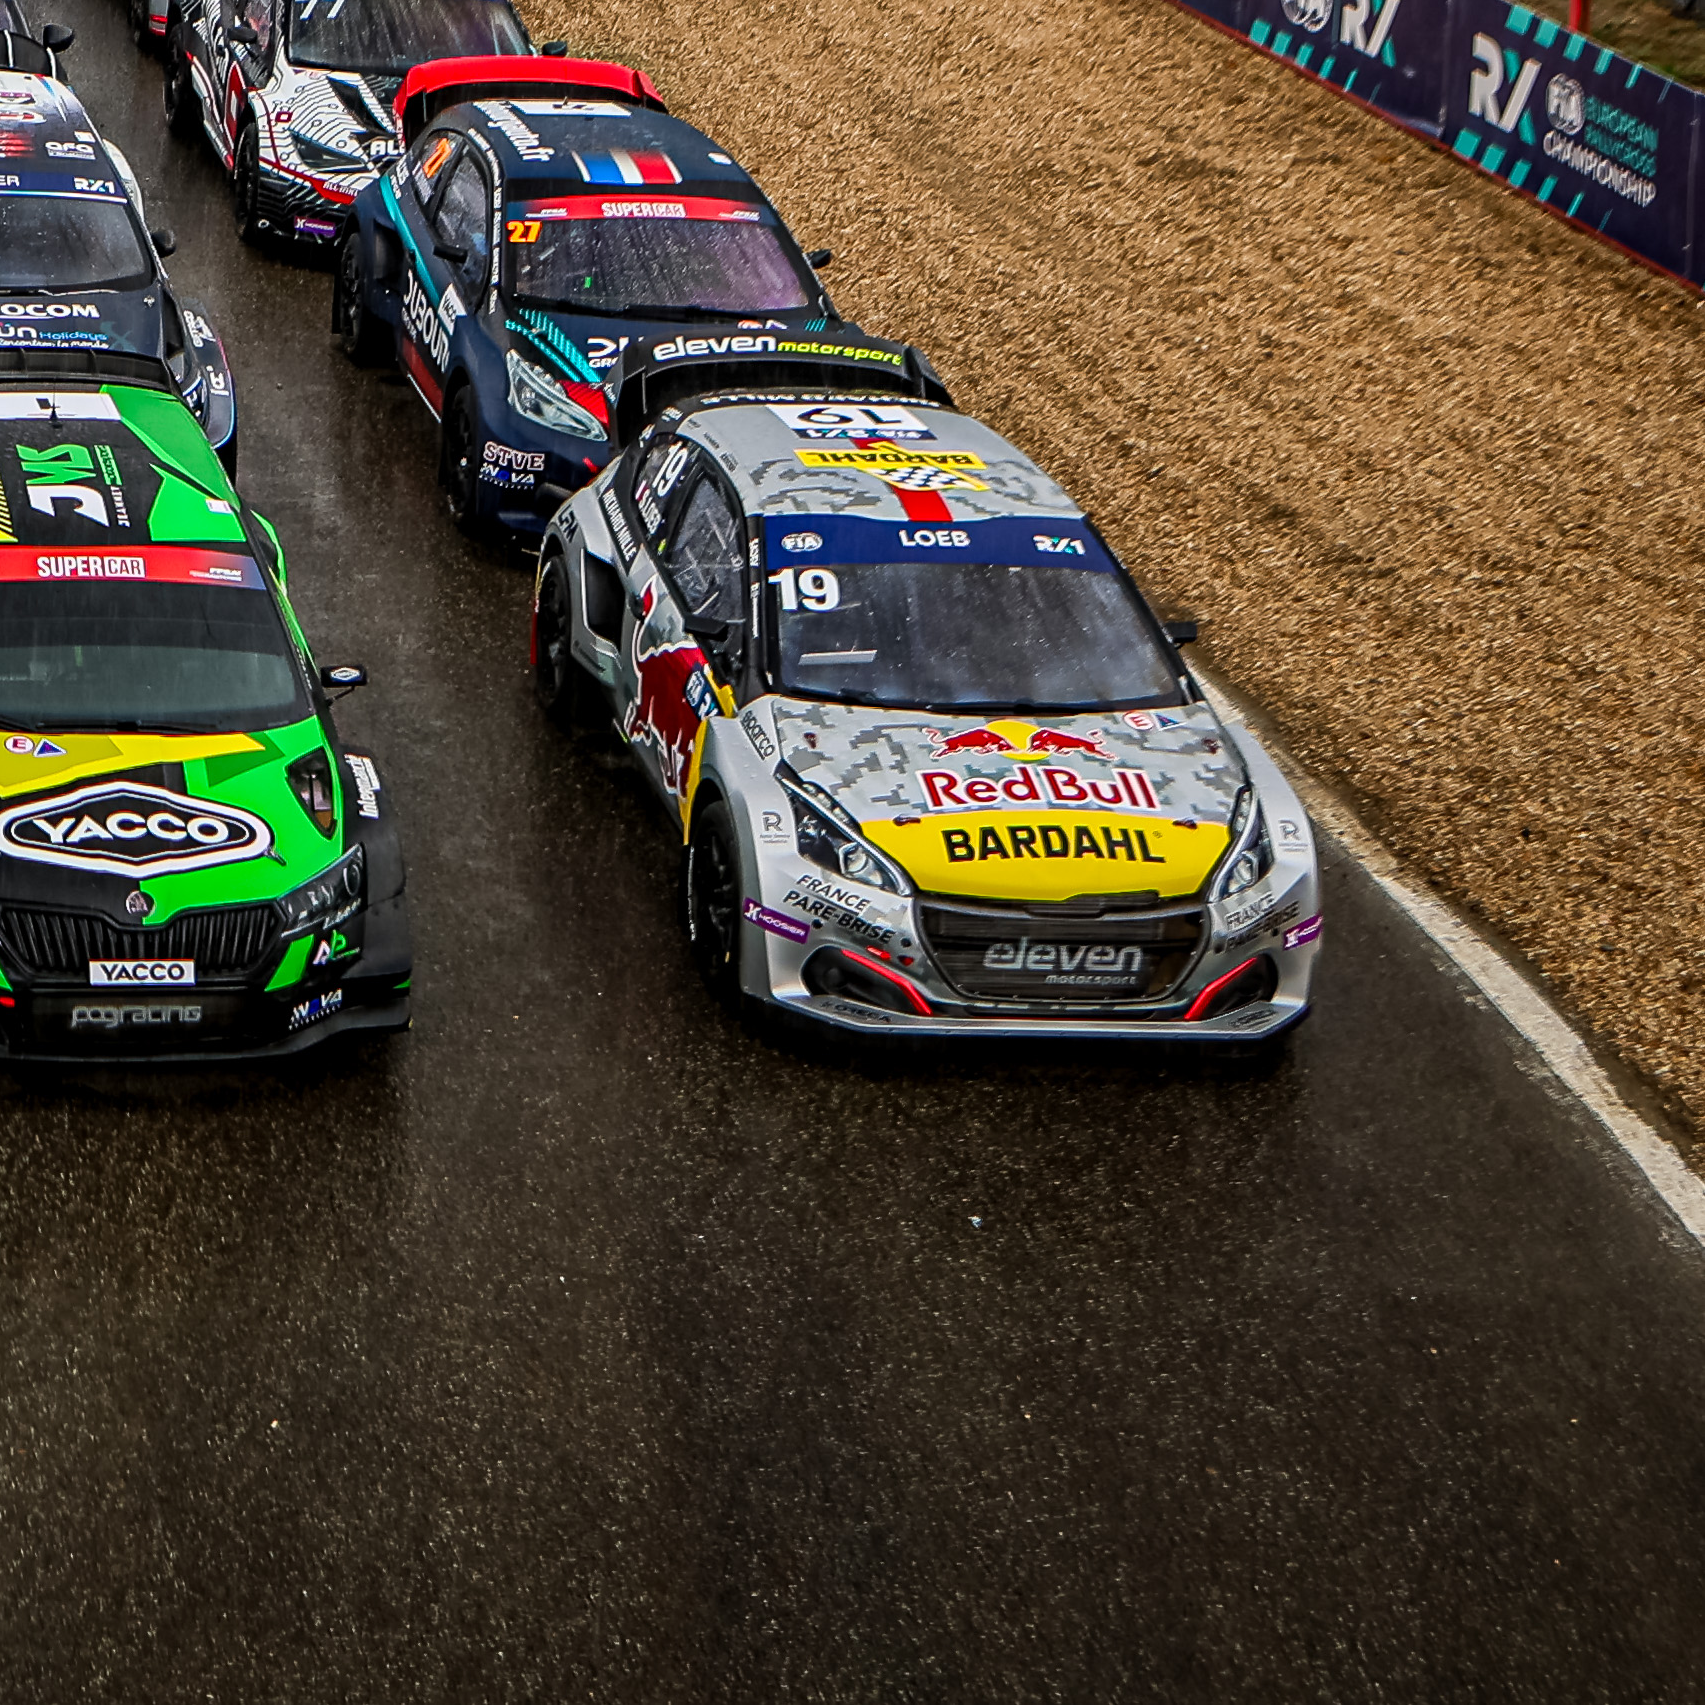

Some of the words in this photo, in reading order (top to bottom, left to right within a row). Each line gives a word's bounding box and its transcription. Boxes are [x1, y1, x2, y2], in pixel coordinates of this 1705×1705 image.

[1543, 131, 1656, 208] CHAMPIONSHIP
[506, 221, 543, 243] 27
[654, 336, 777, 361] eleven
[778, 340, 903, 365] motorsport
[483, 442, 545, 470] STVE
[654, 440, 690, 498] 19
[807, 451, 976, 466] BARDAHL
[900, 529, 970, 549] LOEB
[767, 569, 839, 610] 19
[916, 767, 1038, 810] Red
[1039, 767, 1161, 810] Bull
[32, 811, 230, 846] YACCO
[941, 826, 1166, 864] BARDAHL
[795, 875, 870, 911] FRANCE
[783, 890, 894, 945] PARE-BRISE
[1225, 894, 1275, 928] FRANCE
[1226, 901, 1300, 954] PARE-BRISE
[98, 962, 186, 983] YACCO
[982, 937, 1141, 973] eleven
[1045, 972, 1137, 984] motorsport
